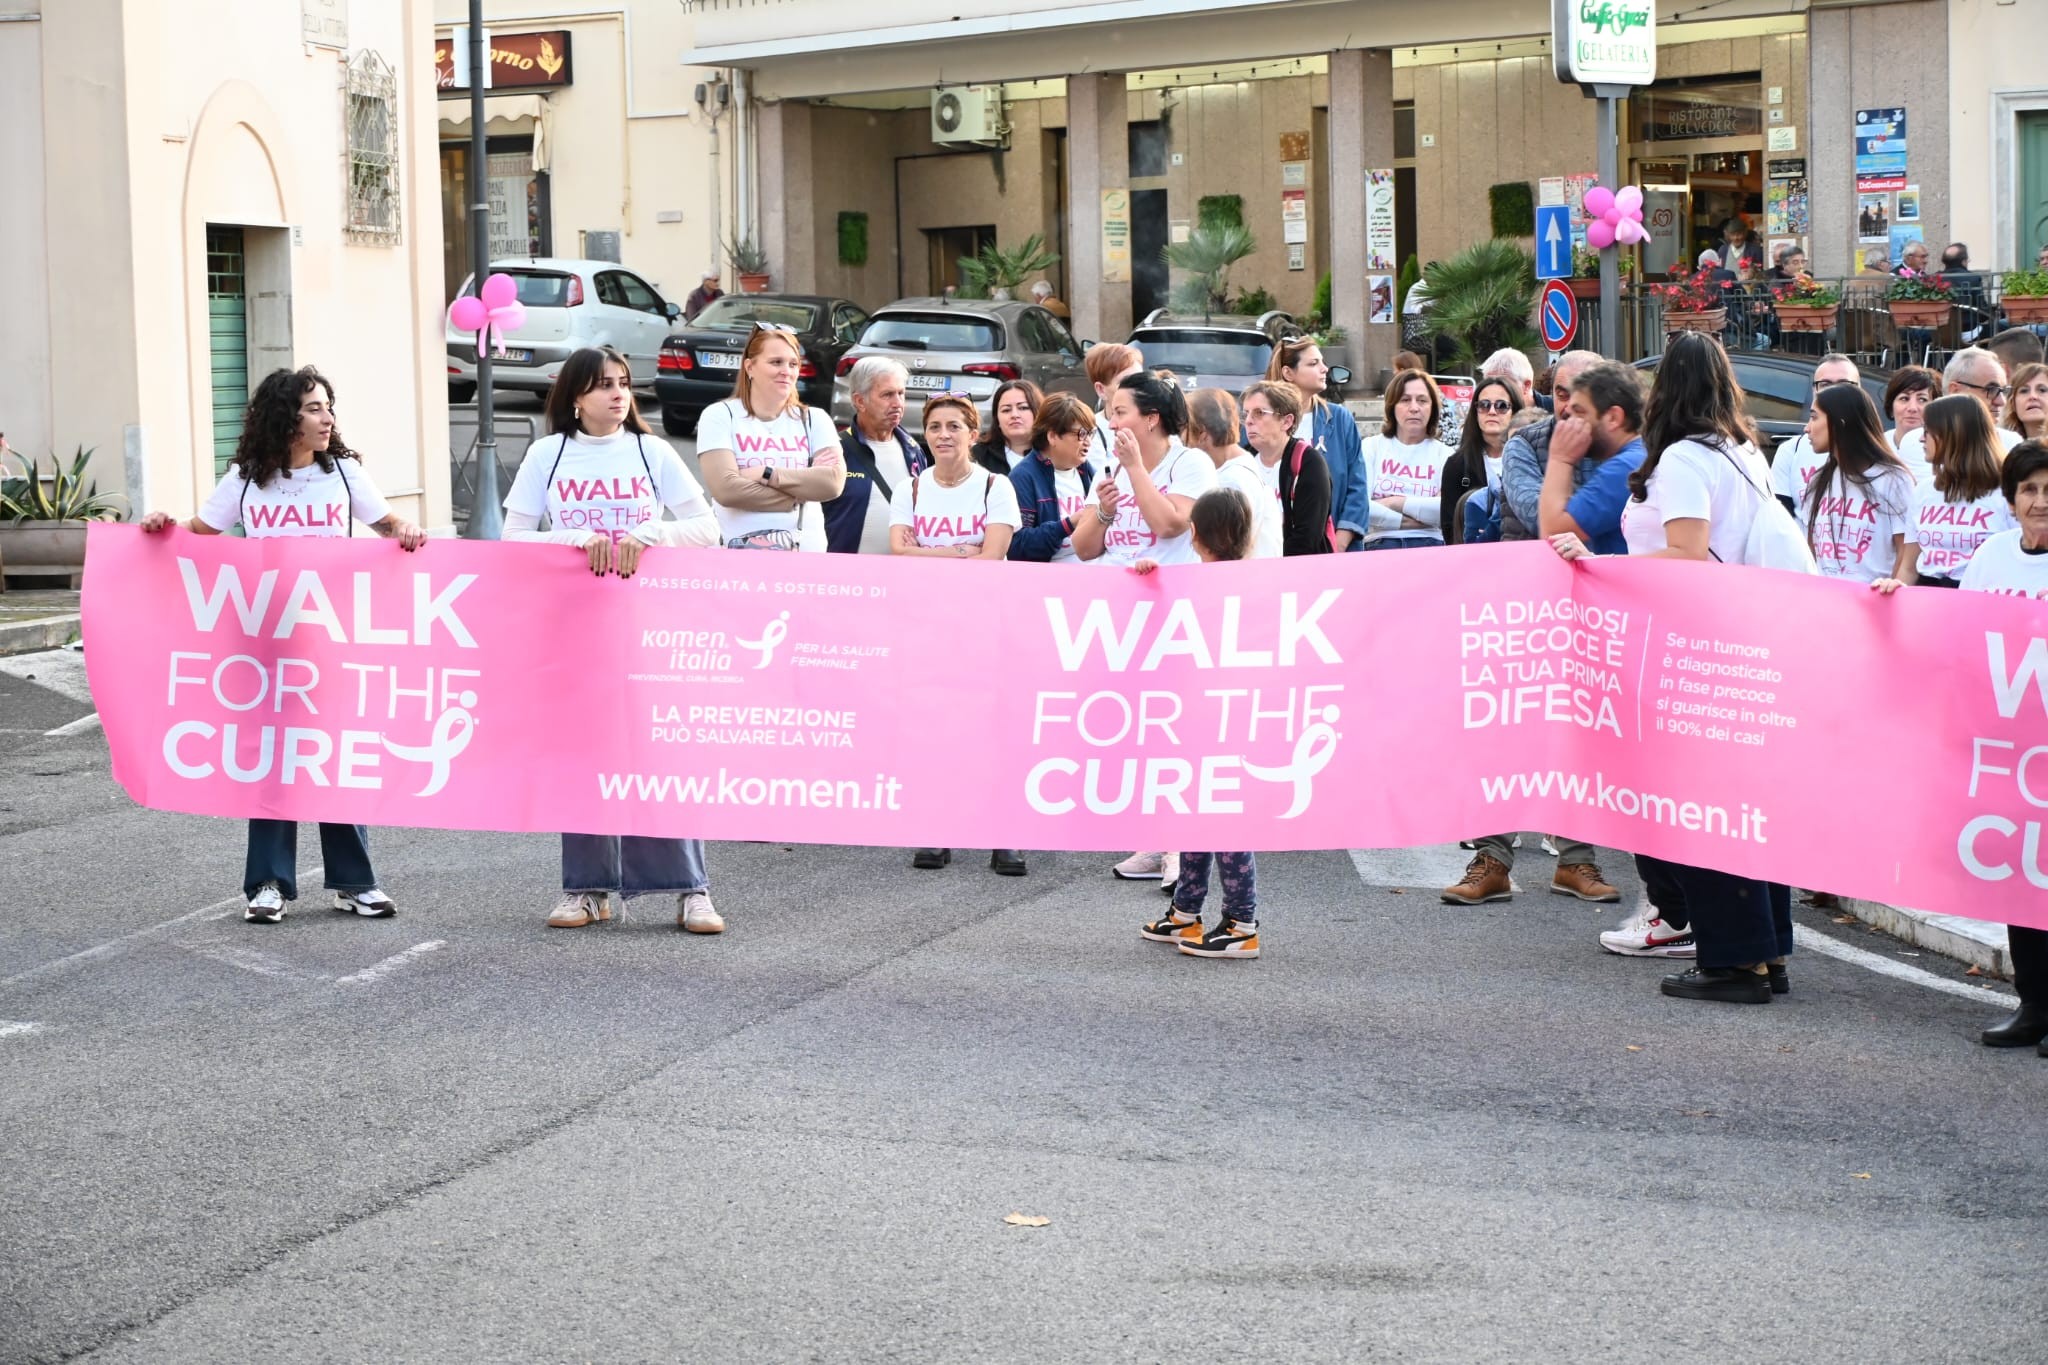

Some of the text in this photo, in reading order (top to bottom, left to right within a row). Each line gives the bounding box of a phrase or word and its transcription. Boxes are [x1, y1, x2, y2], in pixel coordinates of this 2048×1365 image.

[490, 49, 534, 70] orno
[1582, 42, 1649, 63] GELATERIA
[736, 433, 811, 453] WALK
[557, 476, 650, 502] WALK
[250, 503, 344, 529] WALK
[560, 508, 604, 527] FOR
[1820, 497, 1880, 524] WALK
[1920, 505, 1995, 530] WALK
[913, 513, 987, 538] WALK
[1105, 530, 1139, 547] URE
[1917, 530, 1944, 548] OR
[639, 577, 887, 598] PASSEGGIATA A SOSTEGNO DI
[176, 556, 480, 648] WALK
[1044, 588, 1345, 672] WALK
[1460, 598, 1629, 635] LA DIAGNOSI
[794, 643, 891, 658] PER LA SALUTE
[1461, 625, 1625, 667] PRECOCE È
[1666, 632, 1770, 660] Se un tumore
[669, 649, 732, 671] italia
[790, 656, 859, 670] FEMMINILE
[1663, 652, 1782, 683] è diagnosticato
[168, 651, 480, 722] FOR THE
[1461, 657, 1623, 696] LA TUA PRIMA
[1660, 674, 1776, 704] in fase precoce
[651, 704, 857, 729] LA PREVENZIONE
[1032, 684, 1345, 747] FOR THE
[1463, 683, 1623, 738] DIFESA
[1656, 697, 1797, 728] si guarisce in oltre
[651, 724, 854, 748] PUÒ SALVARE LA VITA
[1656, 717, 1765, 746] il 90% dei casi
[162, 720, 383, 790] CURE
[597, 768, 903, 811] www.komen.it
[1024, 755, 1244, 816] CURE
[1480, 770, 1768, 844] www.komen.it
